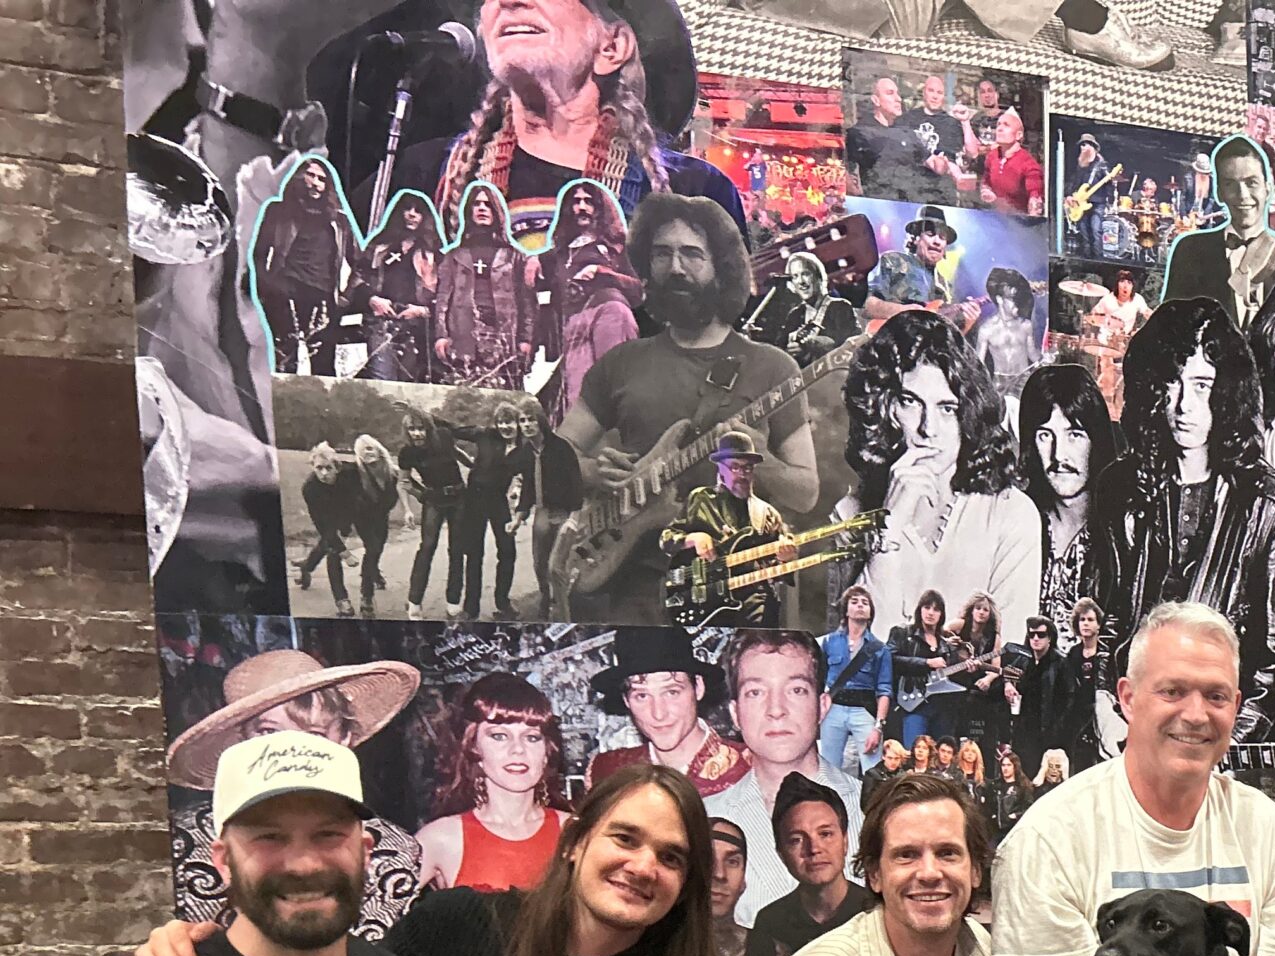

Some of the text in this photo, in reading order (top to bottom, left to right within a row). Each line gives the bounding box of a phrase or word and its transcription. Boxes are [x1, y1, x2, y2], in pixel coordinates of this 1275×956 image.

[752, 166, 762, 179] 5
[247, 744, 335, 775] American
[263, 759, 325, 782] Candy
